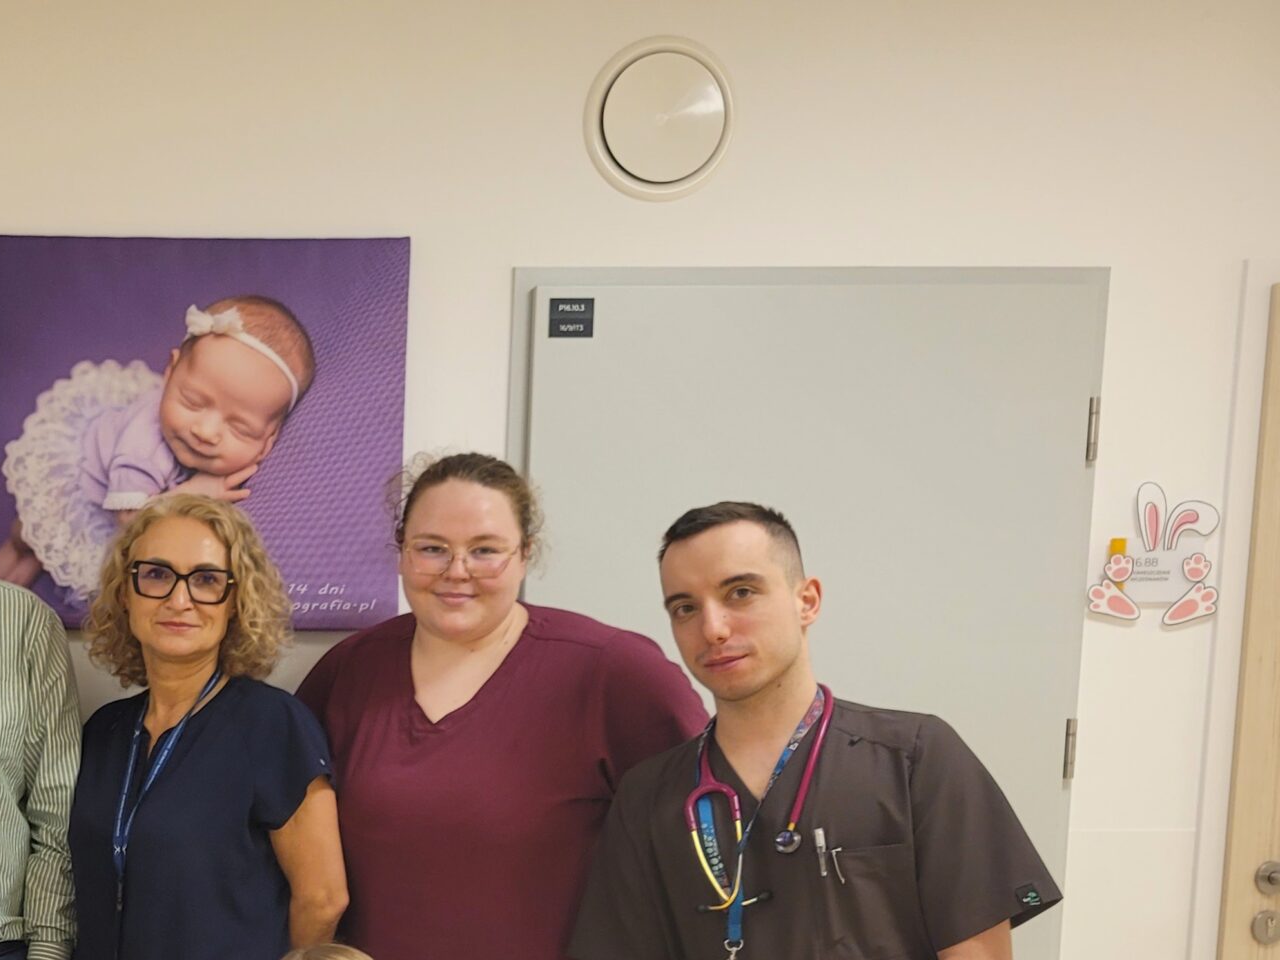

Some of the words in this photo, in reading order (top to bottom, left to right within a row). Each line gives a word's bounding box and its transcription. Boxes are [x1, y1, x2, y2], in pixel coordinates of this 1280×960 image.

[1135, 557, 1159, 568] 6.88
[287, 583, 309, 595] 14
[318, 582, 346, 595] dni
[291, 599, 374, 614] ografia.pl
